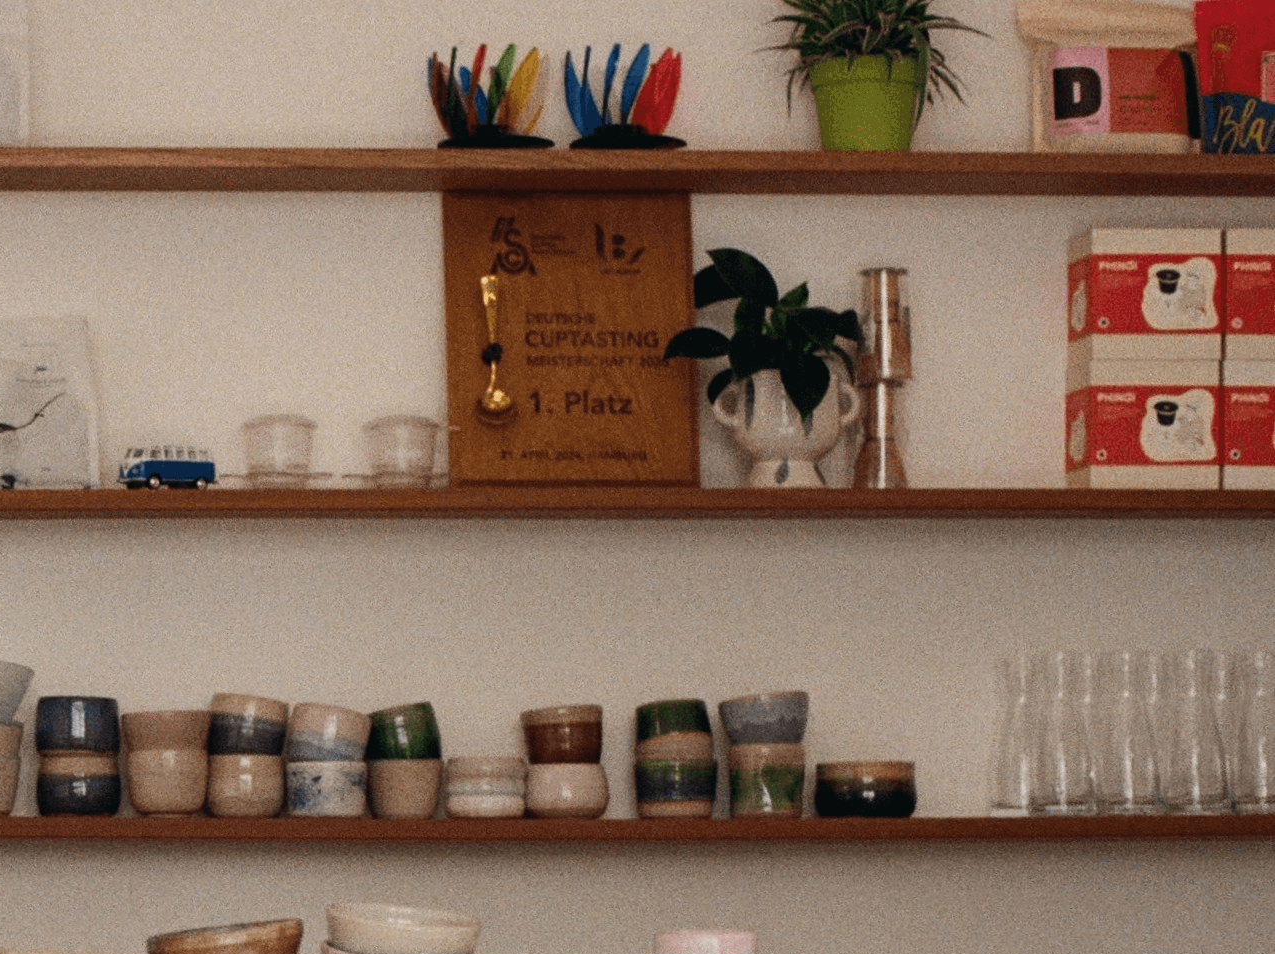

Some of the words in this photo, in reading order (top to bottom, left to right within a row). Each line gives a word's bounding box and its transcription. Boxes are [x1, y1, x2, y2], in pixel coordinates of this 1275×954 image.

[1053, 66, 1102, 121] D
[525, 330, 660, 348] CUPTASTING
[529, 390, 554, 414] 1.
[564, 389, 633, 415] Platz
